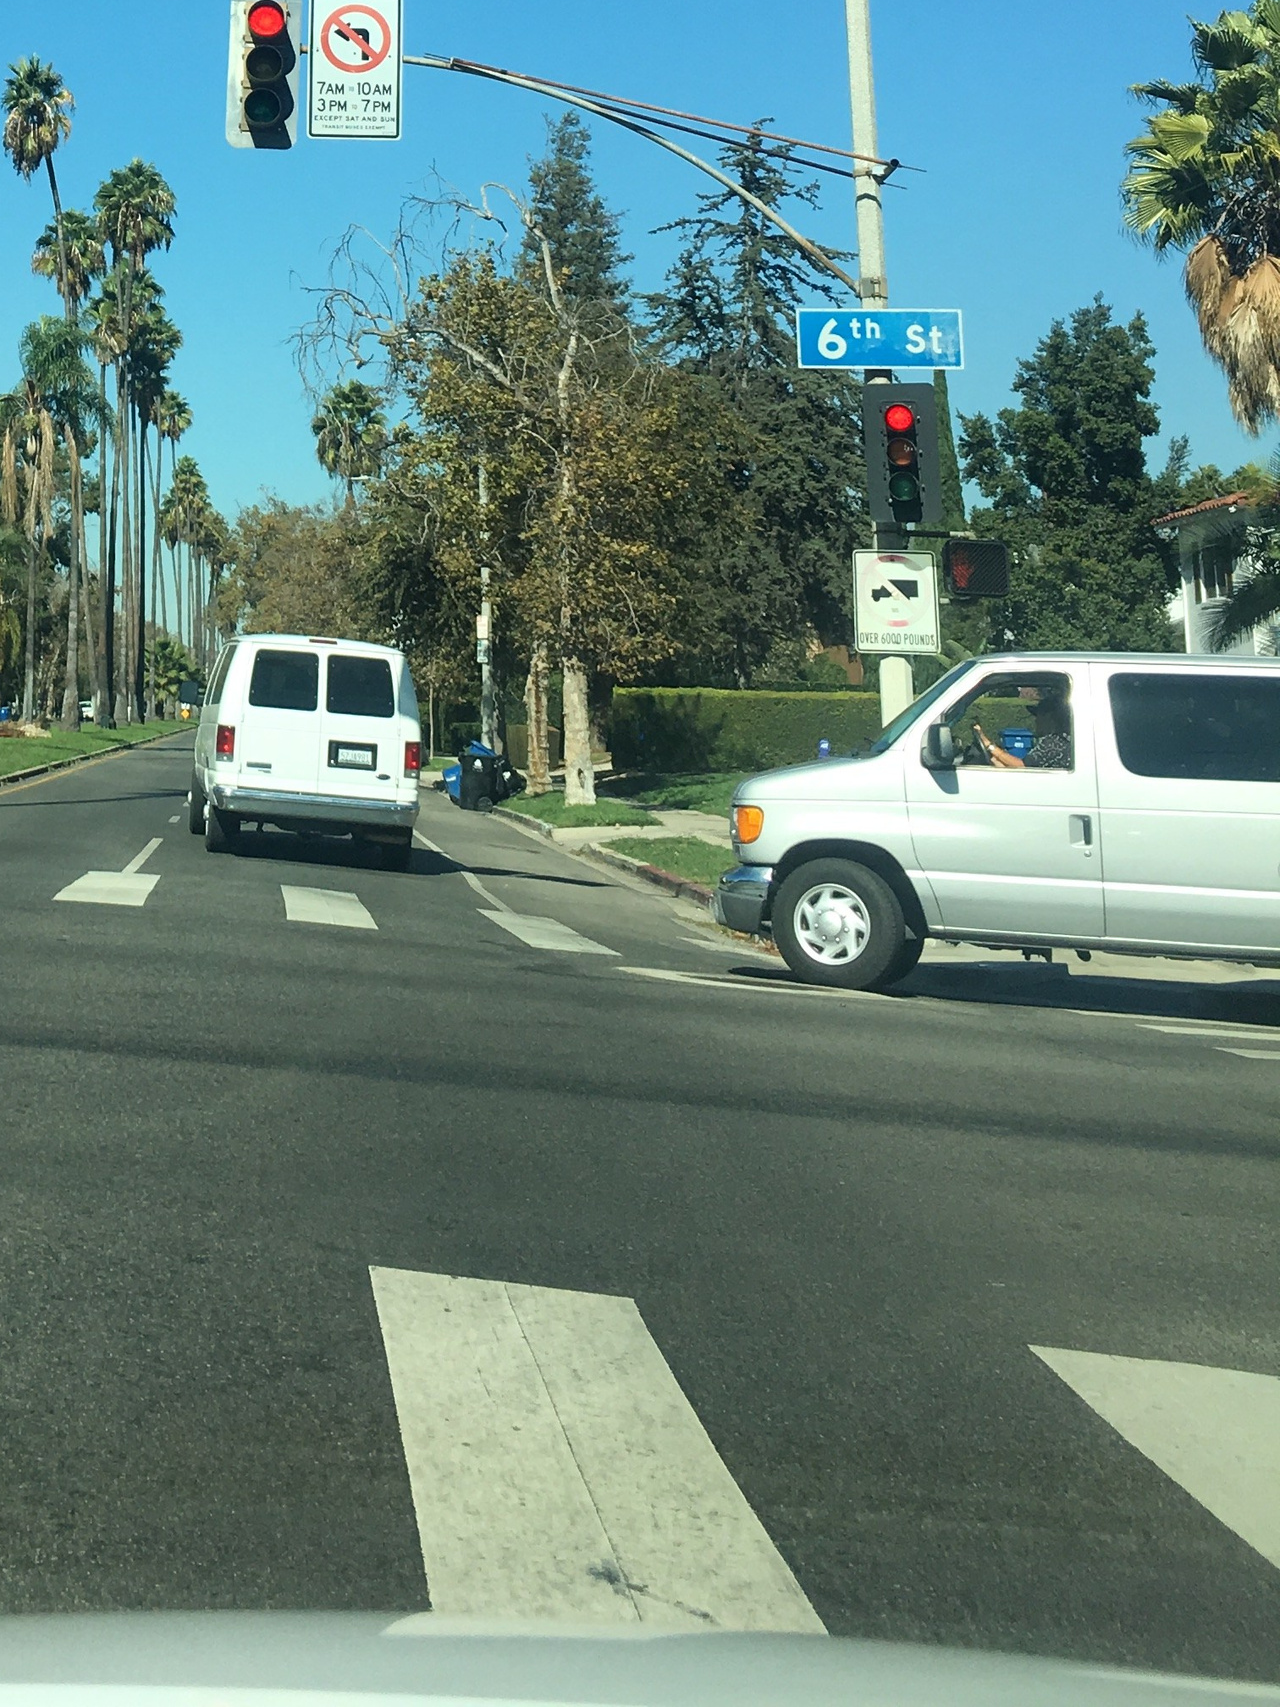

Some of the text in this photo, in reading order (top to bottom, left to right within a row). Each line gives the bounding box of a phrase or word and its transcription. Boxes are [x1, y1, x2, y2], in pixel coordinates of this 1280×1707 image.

[817, 317, 943, 360] 6th St
[859, 632, 936, 646] OVER 6000 POUNDS
